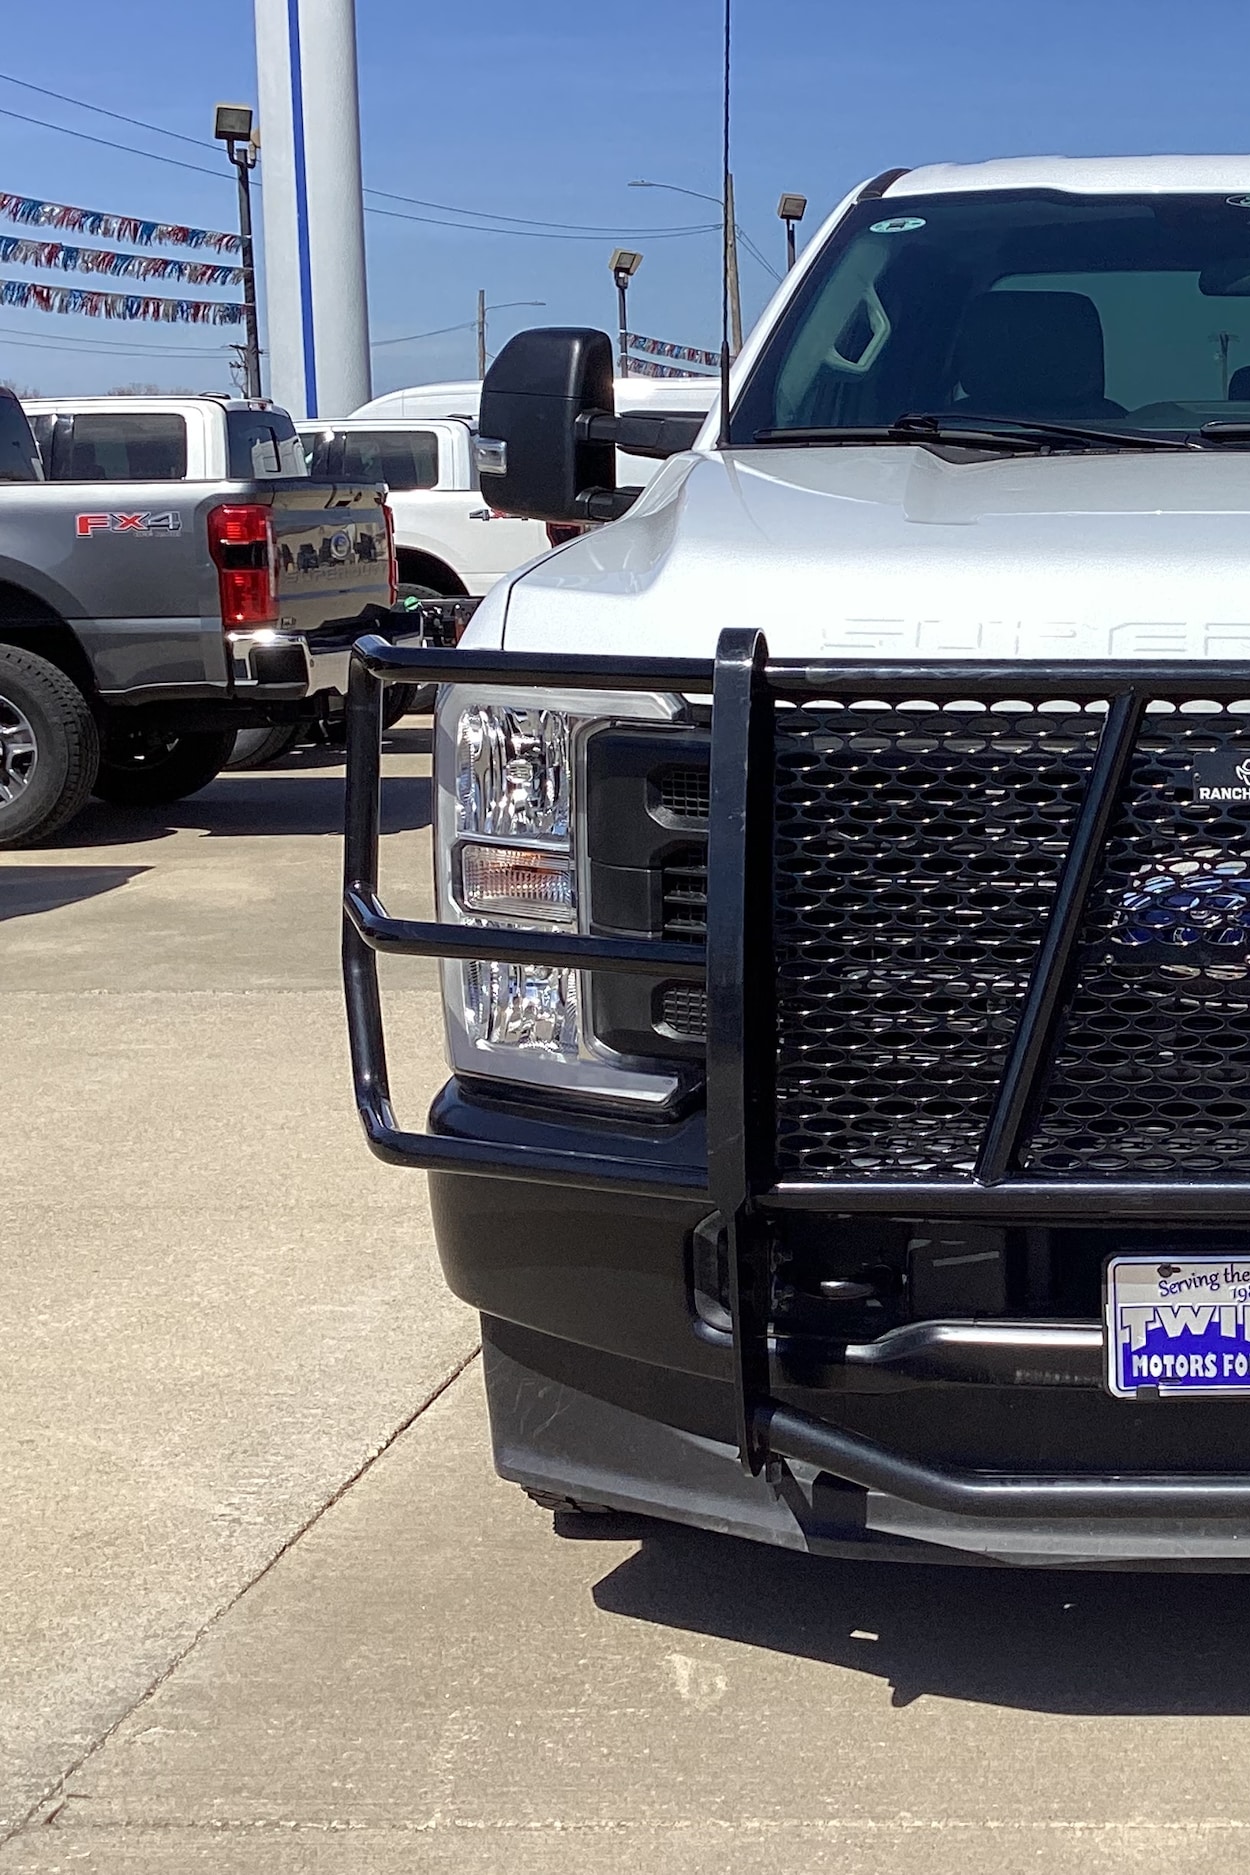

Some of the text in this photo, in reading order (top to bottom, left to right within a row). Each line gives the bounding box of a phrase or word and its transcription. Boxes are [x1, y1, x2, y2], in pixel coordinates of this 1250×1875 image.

[76, 511, 181, 538] FX4
[1158, 1272, 1220, 1298] Serving
[1223, 1263, 1250, 1284] the
[1132, 1352, 1218, 1378] MOTORS
